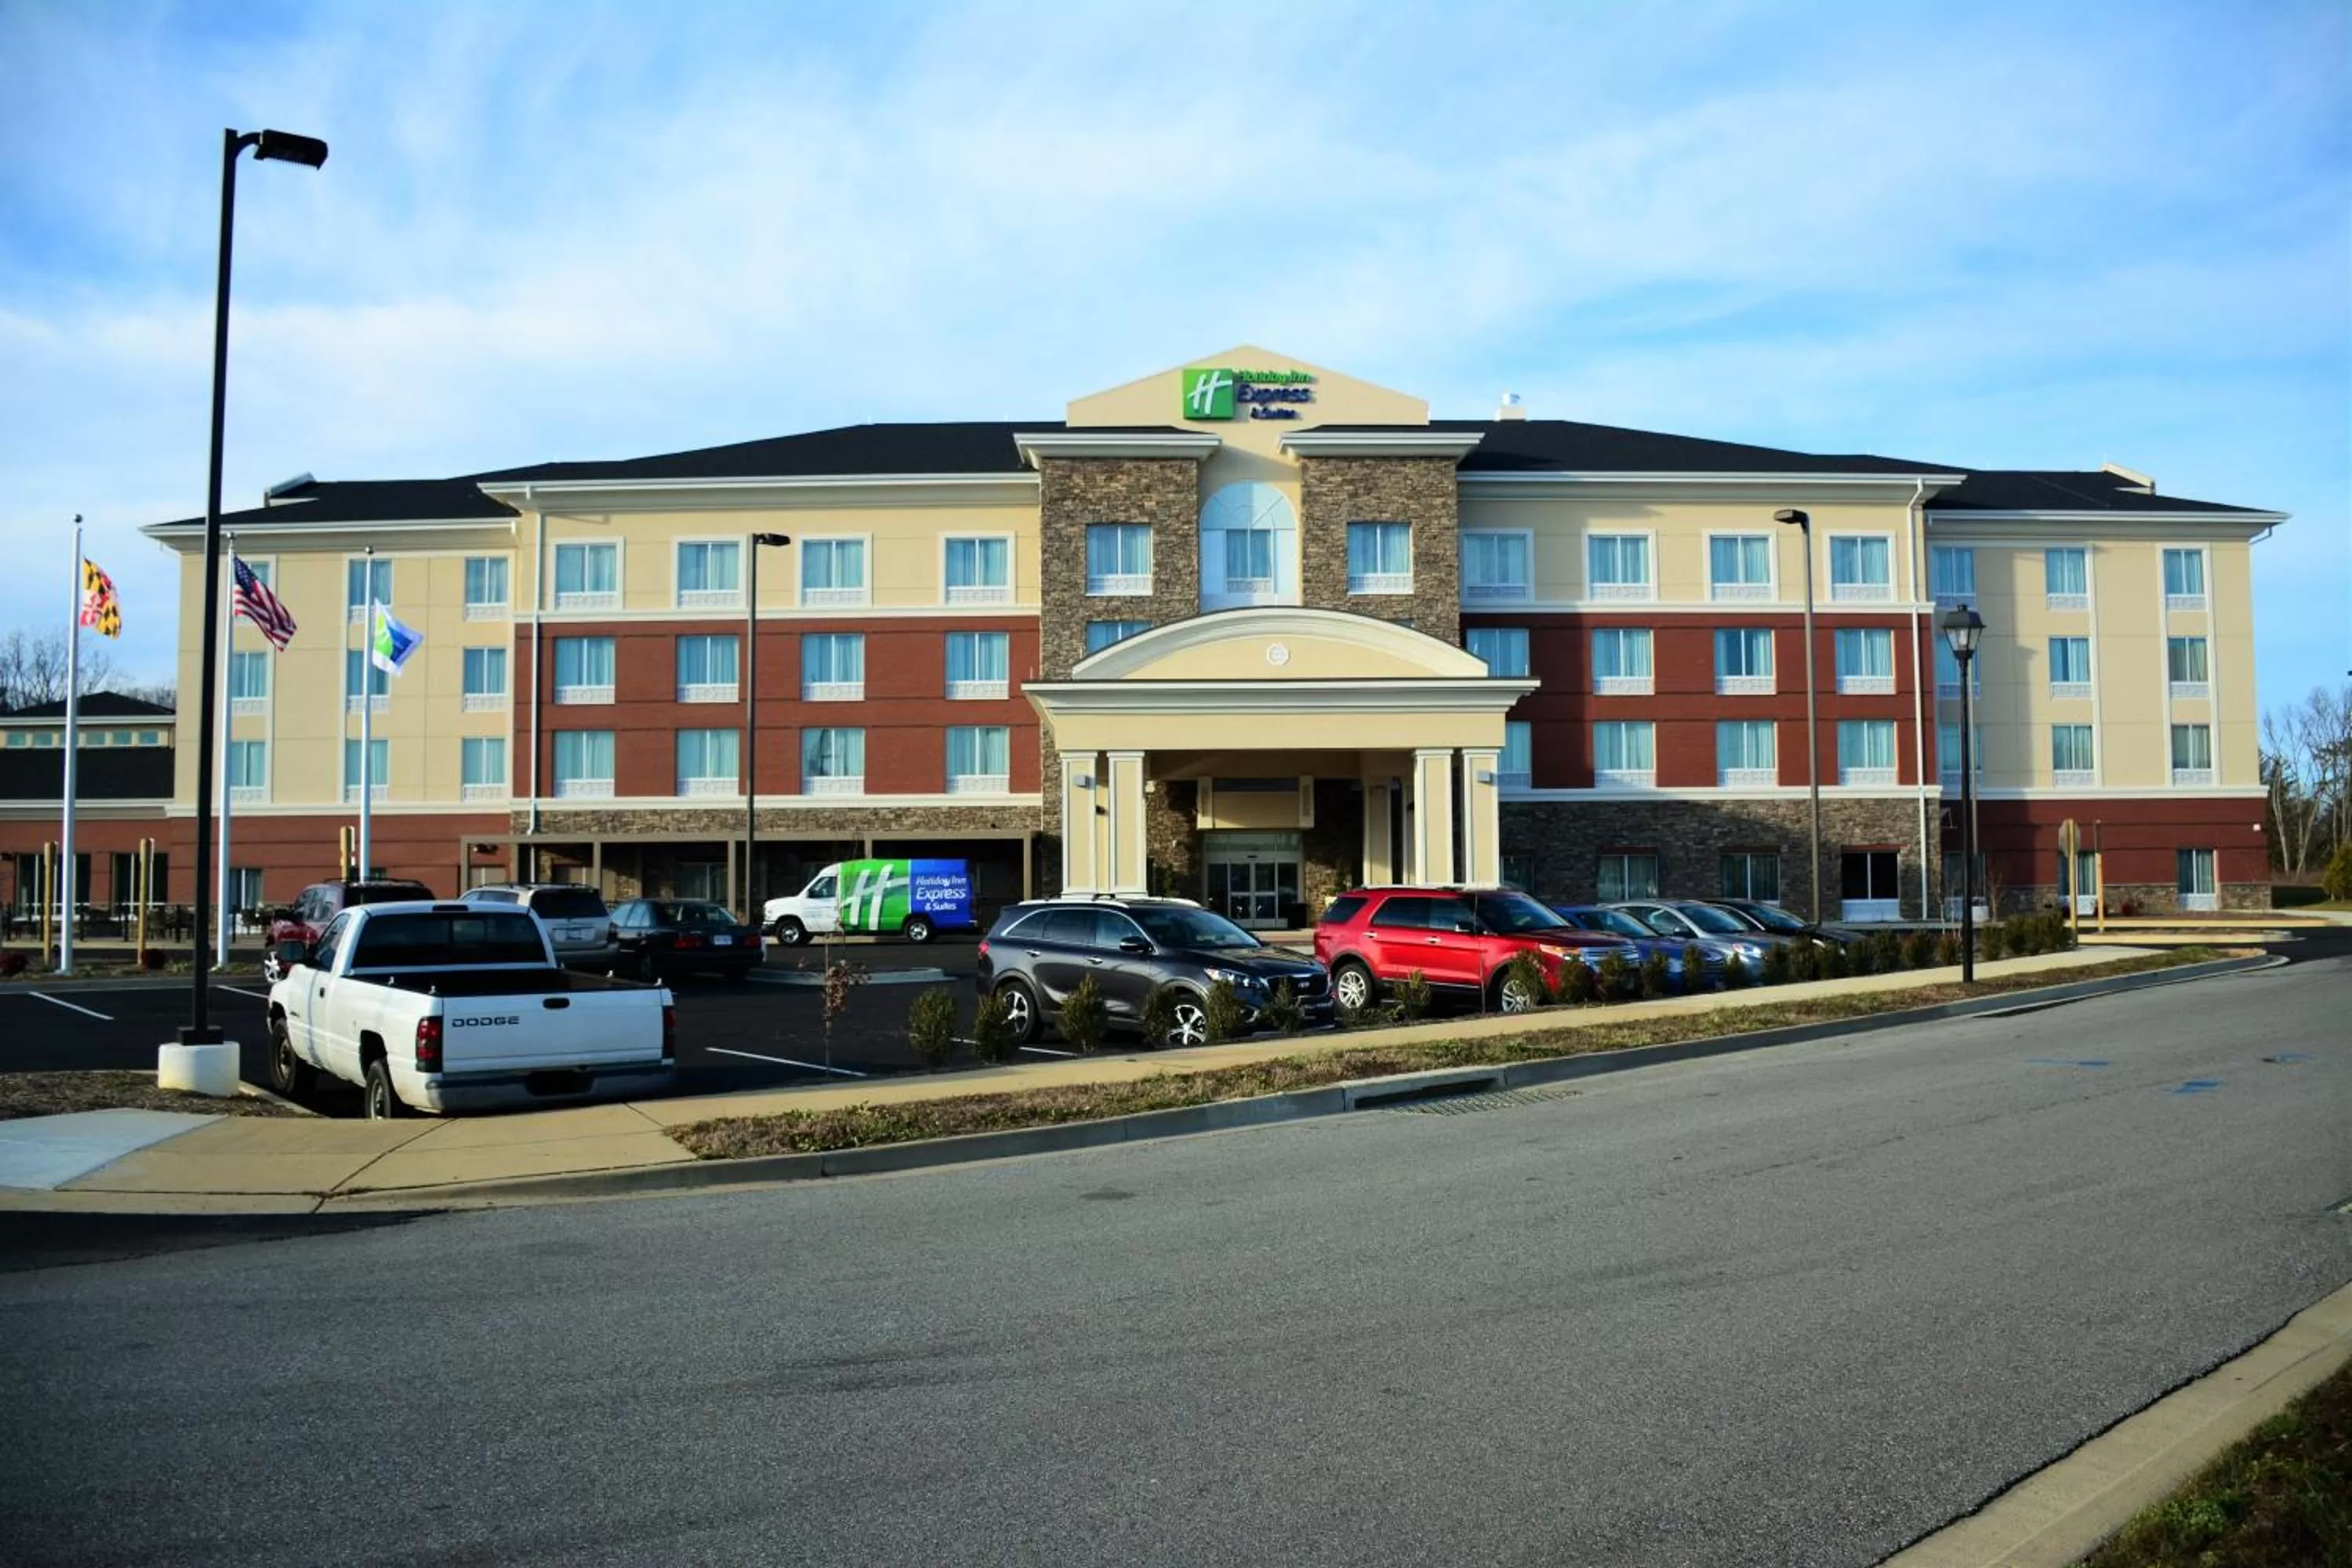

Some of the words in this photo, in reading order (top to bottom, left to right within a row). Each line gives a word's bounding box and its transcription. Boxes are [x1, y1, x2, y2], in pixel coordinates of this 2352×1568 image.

[916, 875, 950, 886] Holiday
[952, 875, 967, 884] Inn
[916, 887, 967, 902] Express
[932, 902, 956, 911] Suites
[452, 1015, 519, 1028] DODGE
